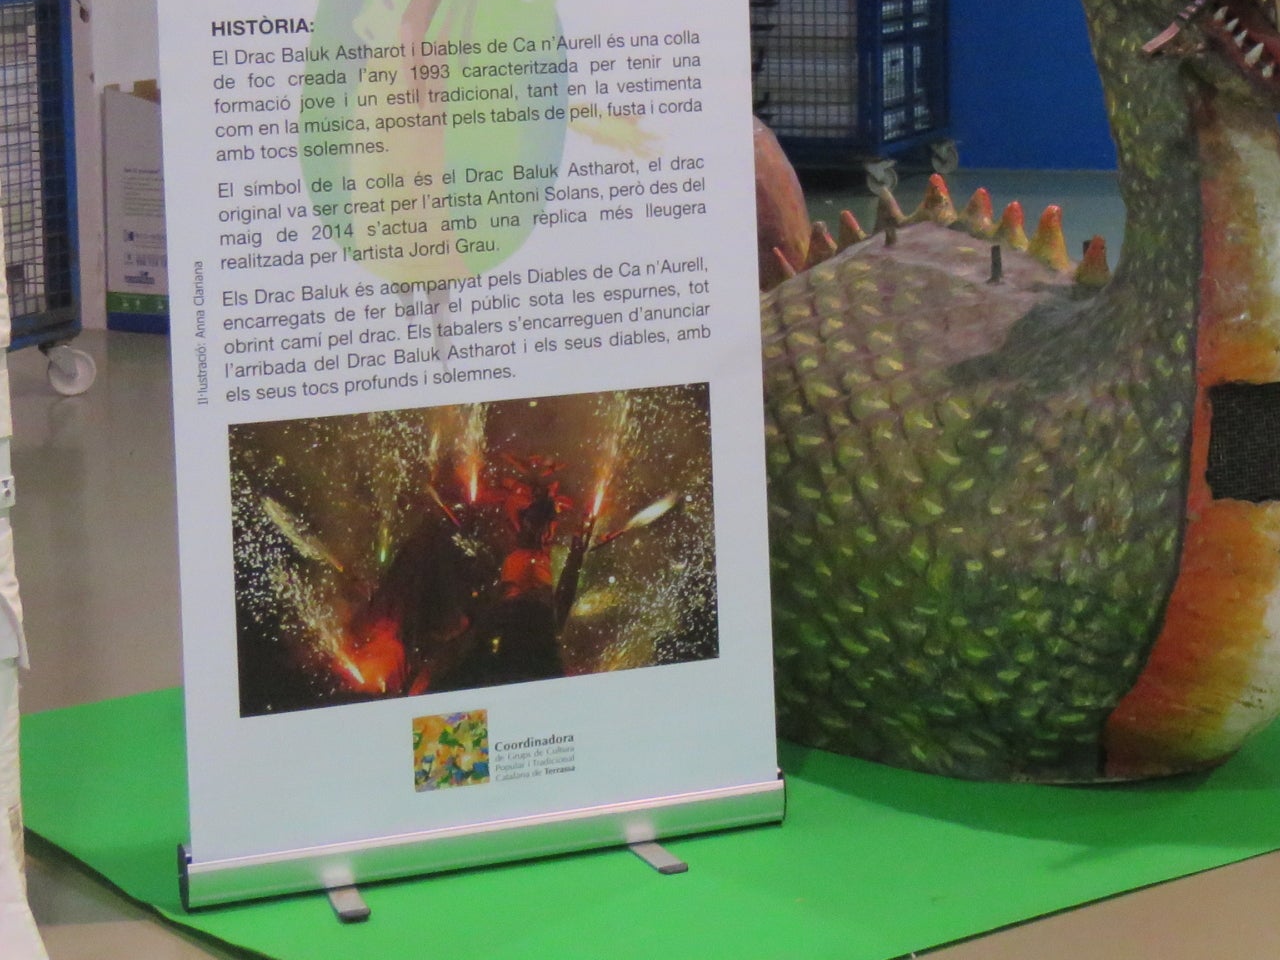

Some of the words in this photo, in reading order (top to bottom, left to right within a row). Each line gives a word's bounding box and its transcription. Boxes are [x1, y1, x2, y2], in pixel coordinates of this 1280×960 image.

[211, 16, 315, 37] HISTÒRIA:
[212, 50, 228, 66] El
[235, 49, 276, 65] Drac
[282, 46, 330, 63] Baluk
[335, 43, 406, 60] Astharot
[420, 40, 482, 57] Diables
[487, 38, 508, 54] de
[513, 37, 537, 53] Ca
[606, 33, 625, 49] és
[630, 35, 659, 47] una
[664, 30, 701, 46] colla
[213, 74, 236, 90] de
[248, 73, 276, 88] foc
[288, 69, 347, 87] creada
[410, 64, 450, 81] 1993
[462, 58, 579, 78] caracteritzada
[590, 60, 616, 76] per
[626, 54, 662, 70] tenir
[673, 56, 702, 68] una
[214, 96, 291, 114] formació
[300, 95, 336, 114] jove
[358, 94, 378, 107] un
[386, 88, 420, 106] estil
[428, 84, 518, 103] tradicional,
[526, 82, 559, 98] tant
[567, 84, 587, 96] en
[595, 80, 609, 95] la
[616, 76, 702, 94] vestimenta
[215, 124, 254, 138] com
[258, 123, 280, 136] en
[285, 119, 300, 134] la
[304, 116, 370, 134] música,
[375, 112, 448, 133] apostant
[452, 108, 486, 129] pels
[490, 106, 540, 123] tabals
[544, 105, 566, 120] de
[569, 102, 602, 123] pell,
[607, 102, 646, 117] fusta
[658, 98, 703, 114] corda
[216, 145, 255, 162] amb
[260, 145, 298, 159] tocs
[303, 140, 389, 157] solemnes.
[218, 204, 282, 225] original
[287, 206, 308, 218] va
[312, 204, 339, 217] ser
[344, 198, 386, 215] creat
[390, 198, 418, 215] per
[487, 187, 539, 205] Antoni
[544, 186, 604, 202] Solans,
[609, 180, 645, 201] però
[650, 180, 678, 195] des
[682, 177, 705, 193] del
[220, 229, 262, 248] maig
[276, 227, 299, 243] de
[312, 222, 354, 241] 2014
[440, 214, 477, 232] amb
[490, 216, 521, 228] una
[533, 208, 588, 228] rèplica
[600, 205, 634, 221] més
[646, 203, 707, 220] lleugera
[221, 250, 305, 270] realitzada
[310, 251, 338, 268] per
[408, 240, 450, 258] Jordi
[455, 238, 500, 254] Grau.
[194, 261, 204, 306] Clariana
[195, 310, 205, 338] Anna
[224, 336, 275, 355] obrint
[280, 332, 322, 351] camí
[328, 330, 353, 351] pel
[359, 328, 401, 344] drac.
[408, 324, 432, 340] Els
[436, 320, 503, 338] tabalers
[226, 386, 251, 403] els
[256, 386, 297, 400] seus
[302, 382, 339, 396] tocs
[344, 372, 419, 397] profunds
[433, 367, 516, 385] solemnes.
[494, 734, 574, 752] Coordinadora
